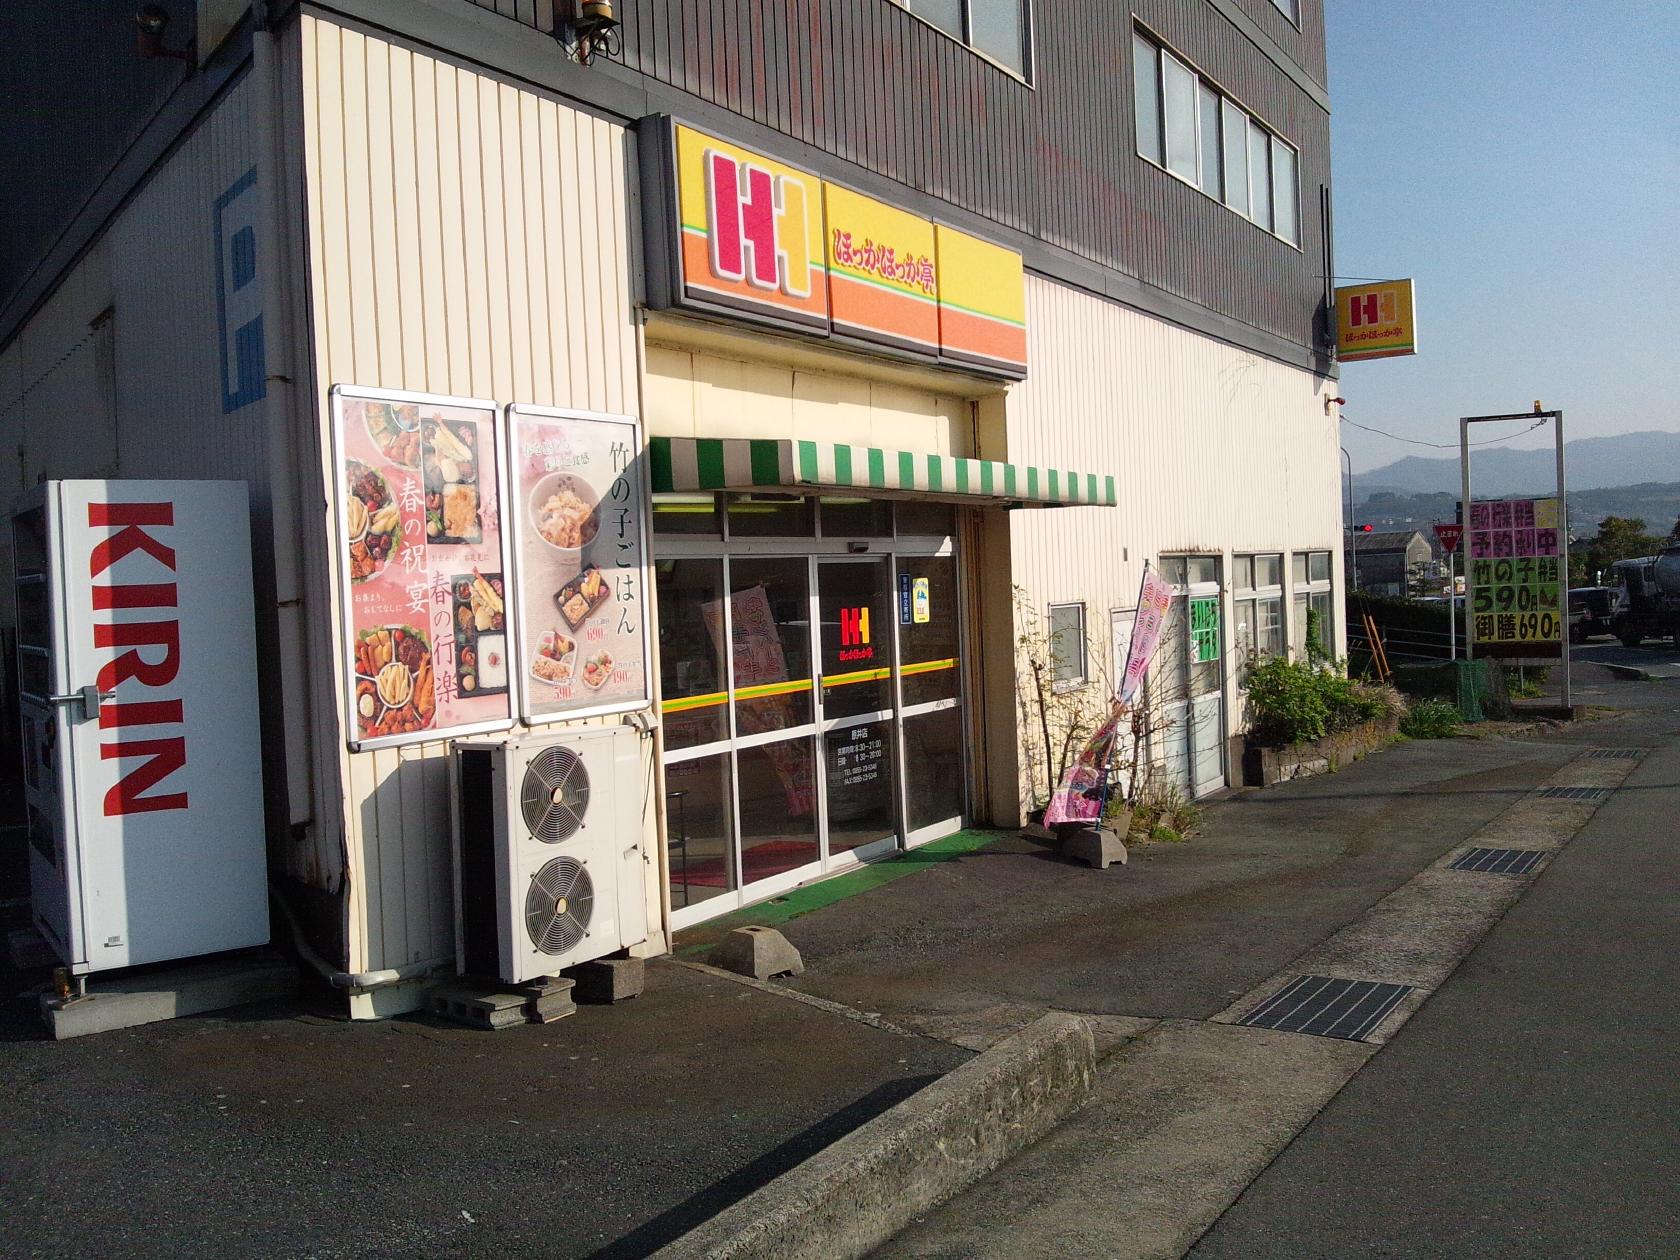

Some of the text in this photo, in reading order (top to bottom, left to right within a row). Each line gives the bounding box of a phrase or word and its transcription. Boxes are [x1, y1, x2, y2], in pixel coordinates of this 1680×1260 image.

[833, 228, 935, 296] ほっかほっか亭
[399, 476, 430, 614] 春の祝宴
[609, 441, 636, 636] 竹の子ごはん
[88, 501, 189, 817] KIRIN
[430, 570, 459, 705] 春の行楽
